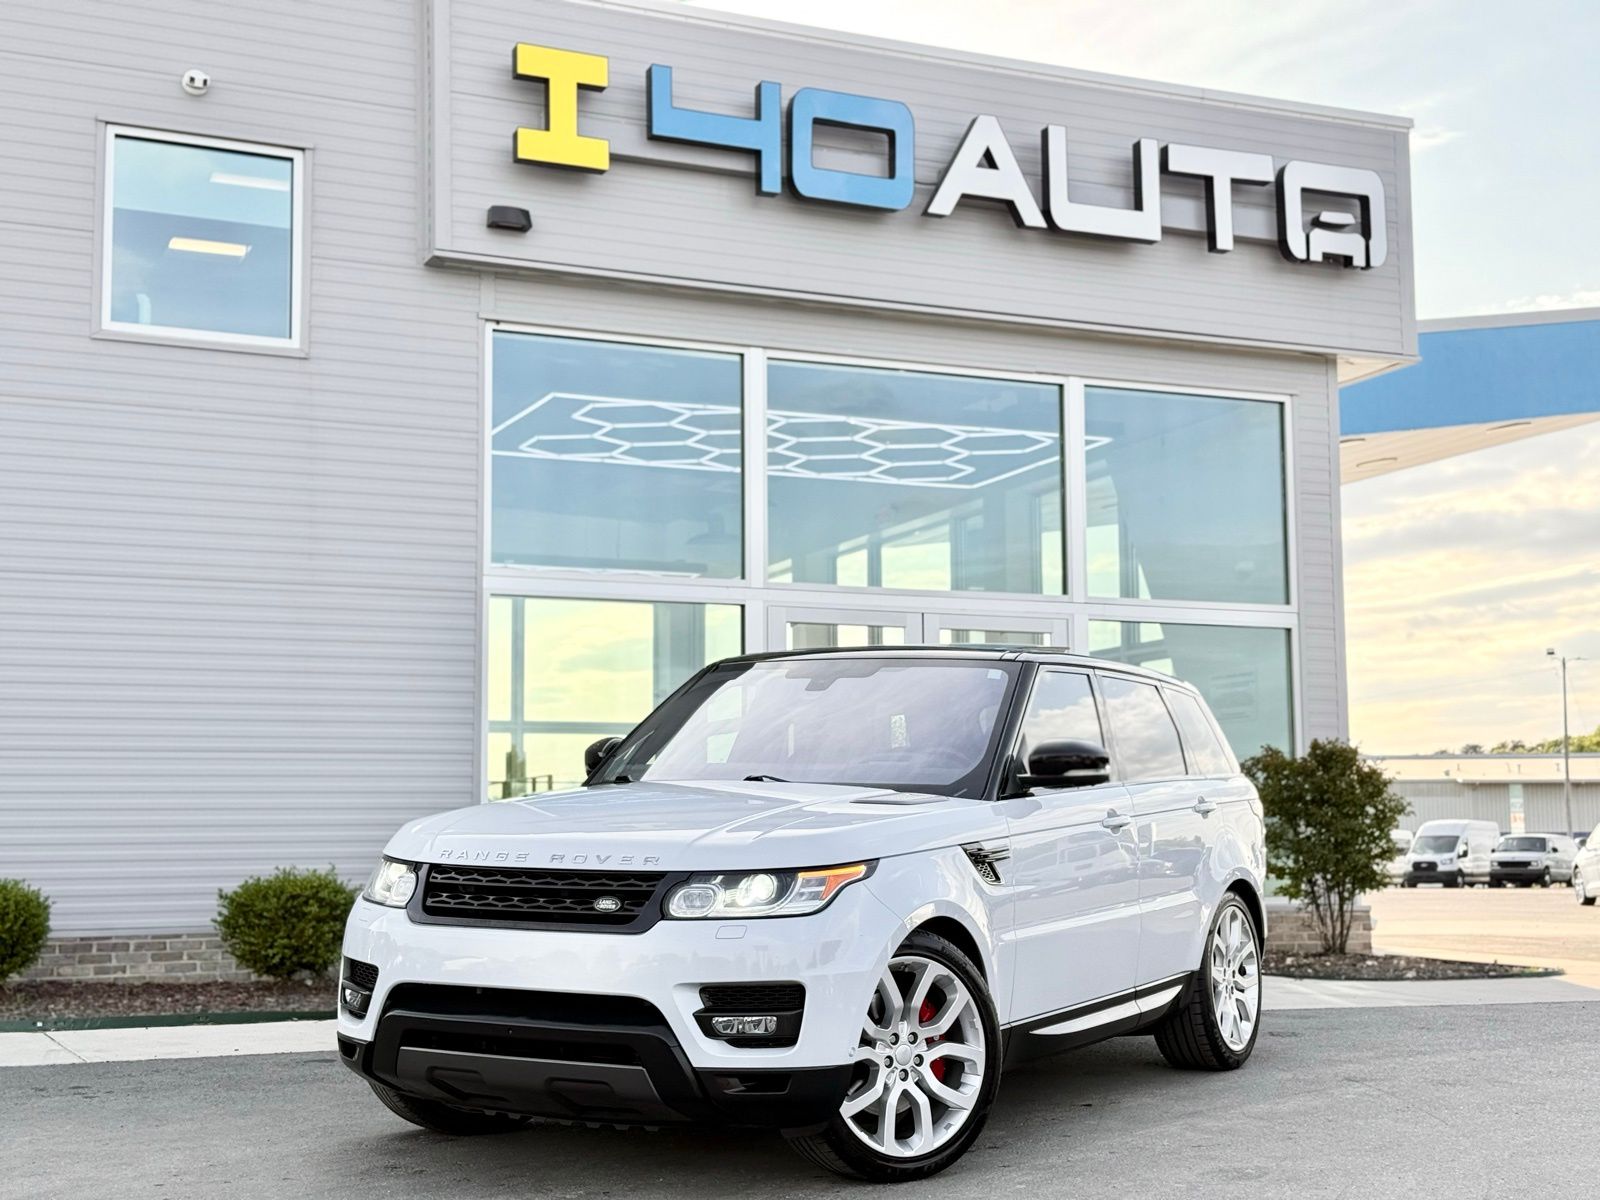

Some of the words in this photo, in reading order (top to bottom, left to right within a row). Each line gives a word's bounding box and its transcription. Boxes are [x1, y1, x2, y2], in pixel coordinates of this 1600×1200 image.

[922, 114, 1388, 271] AUTO
[439, 849, 530, 863] RANGE
[549, 853, 661, 866] ROVER
